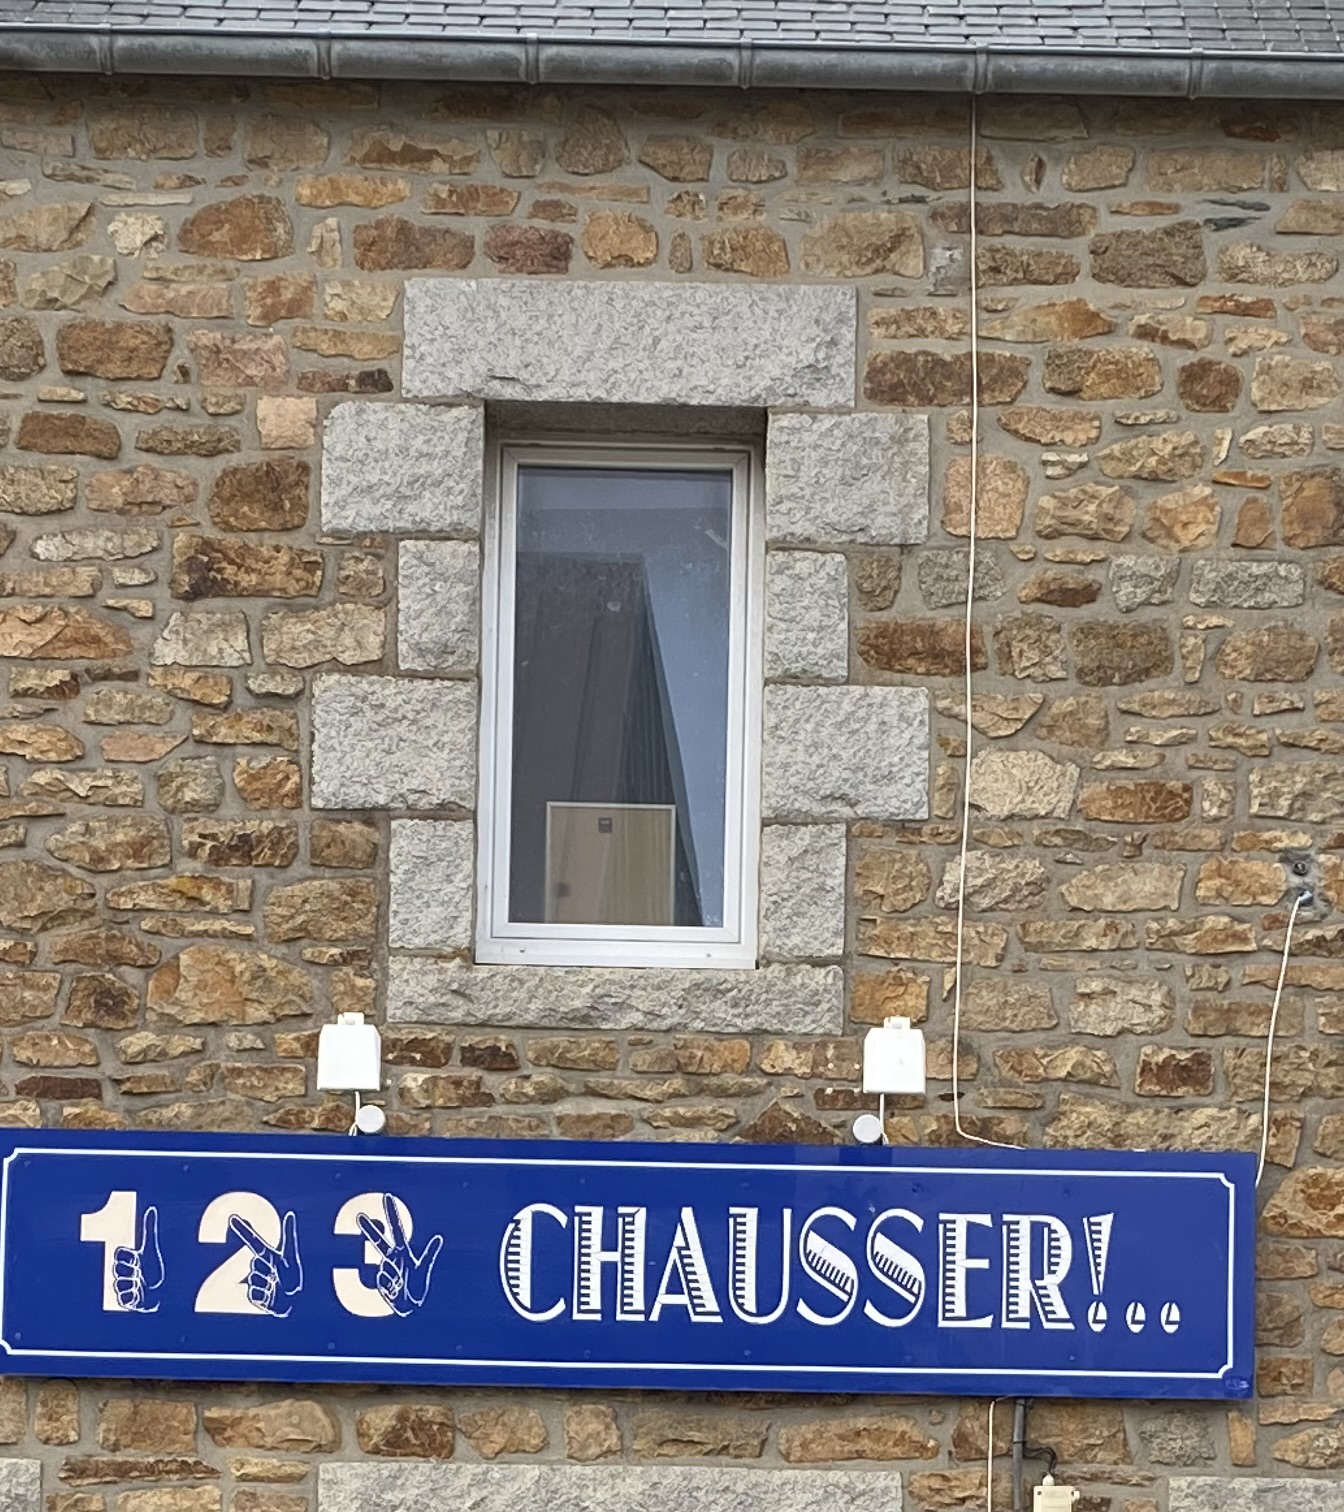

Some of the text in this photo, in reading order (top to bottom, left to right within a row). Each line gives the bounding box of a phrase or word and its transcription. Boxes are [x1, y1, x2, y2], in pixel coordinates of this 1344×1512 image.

[80, 1190, 138, 1312] 1
[195, 1191, 286, 1315] 2
[333, 1192, 414, 1318] 3
